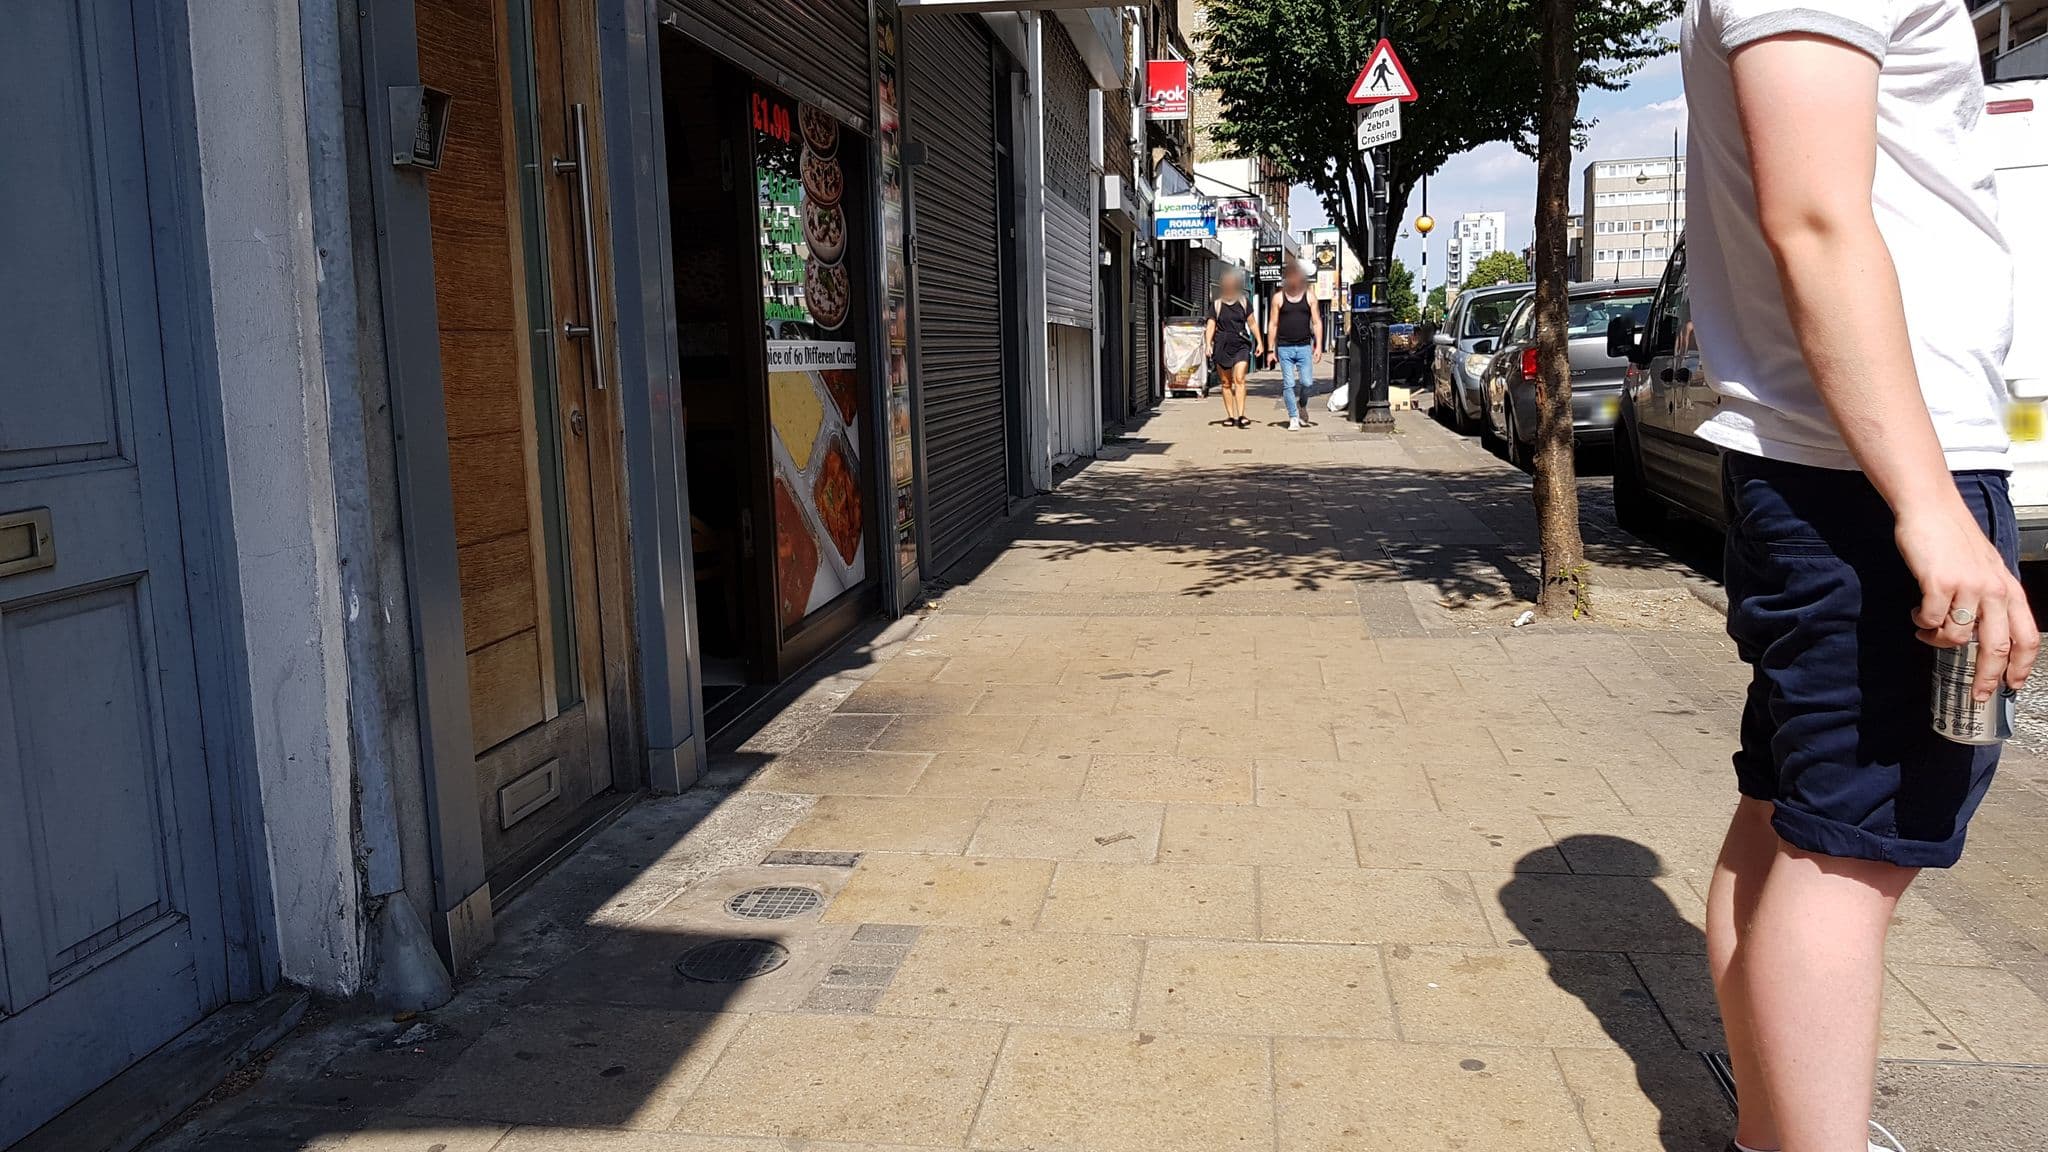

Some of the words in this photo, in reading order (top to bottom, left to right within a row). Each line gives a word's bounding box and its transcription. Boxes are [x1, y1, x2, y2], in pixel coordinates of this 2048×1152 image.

[752, 92, 791, 144] £1.99
[1361, 104, 1395, 121] Humped
[1367, 120, 1390, 132] Zebra
[1361, 130, 1397, 146] Crossing
[1168, 220, 1205, 229] ROMAN
[1163, 228, 1210, 238] GROCERS
[784, 345, 793, 365] of
[804, 346, 836, 364] Different
